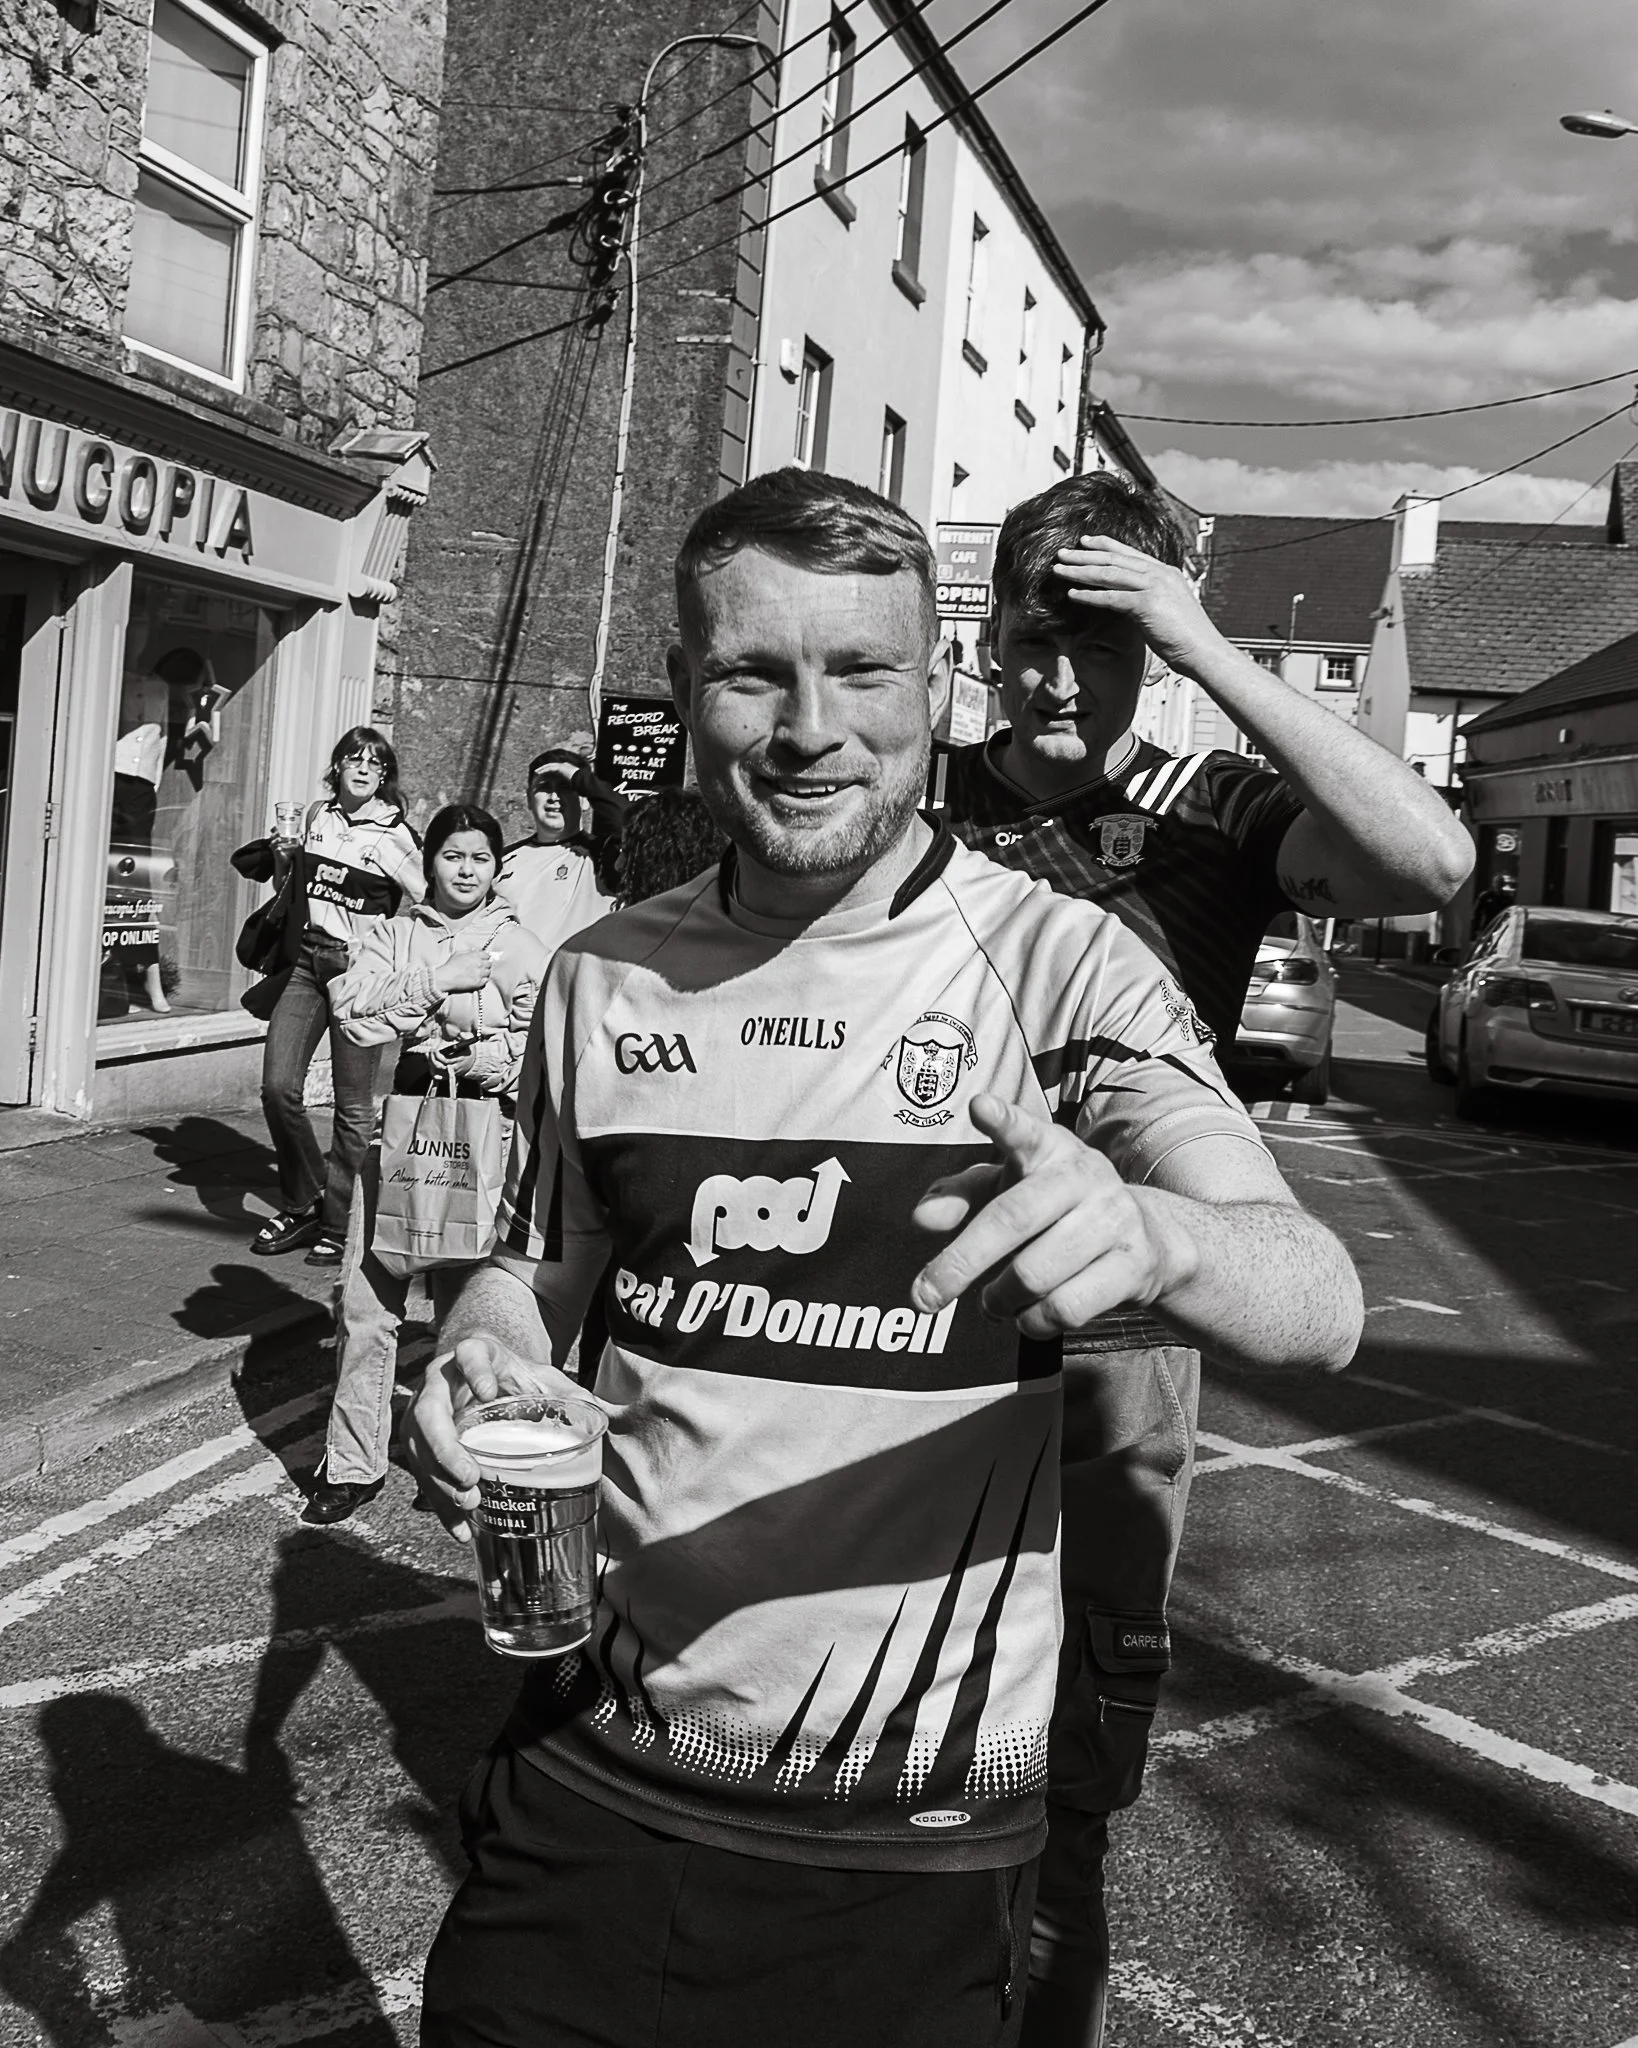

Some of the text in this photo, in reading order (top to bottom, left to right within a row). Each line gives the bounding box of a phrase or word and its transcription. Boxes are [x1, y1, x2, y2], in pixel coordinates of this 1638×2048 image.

[936, 586, 987, 602] OPEN
[612, 704, 628, 712] THE
[607, 711, 664, 726] RECORD
[632, 723, 680, 737] BREAK
[653, 736, 676, 745] CAFE
[613, 755, 666, 768] MUSIC ART
[622, 768, 655, 780] POETRY
[120, 929, 160, 946] ONLINE
[740, 1016, 846, 1050] O'NEILLS
[407, 1139, 470, 1160] DUNNES
[443, 1160, 470, 1171] STORES
[615, 1268, 958, 1354] Pat O'Donnell
[481, 1495, 537, 1512] eineken
[1123, 1634, 1158, 1648] CARPE
